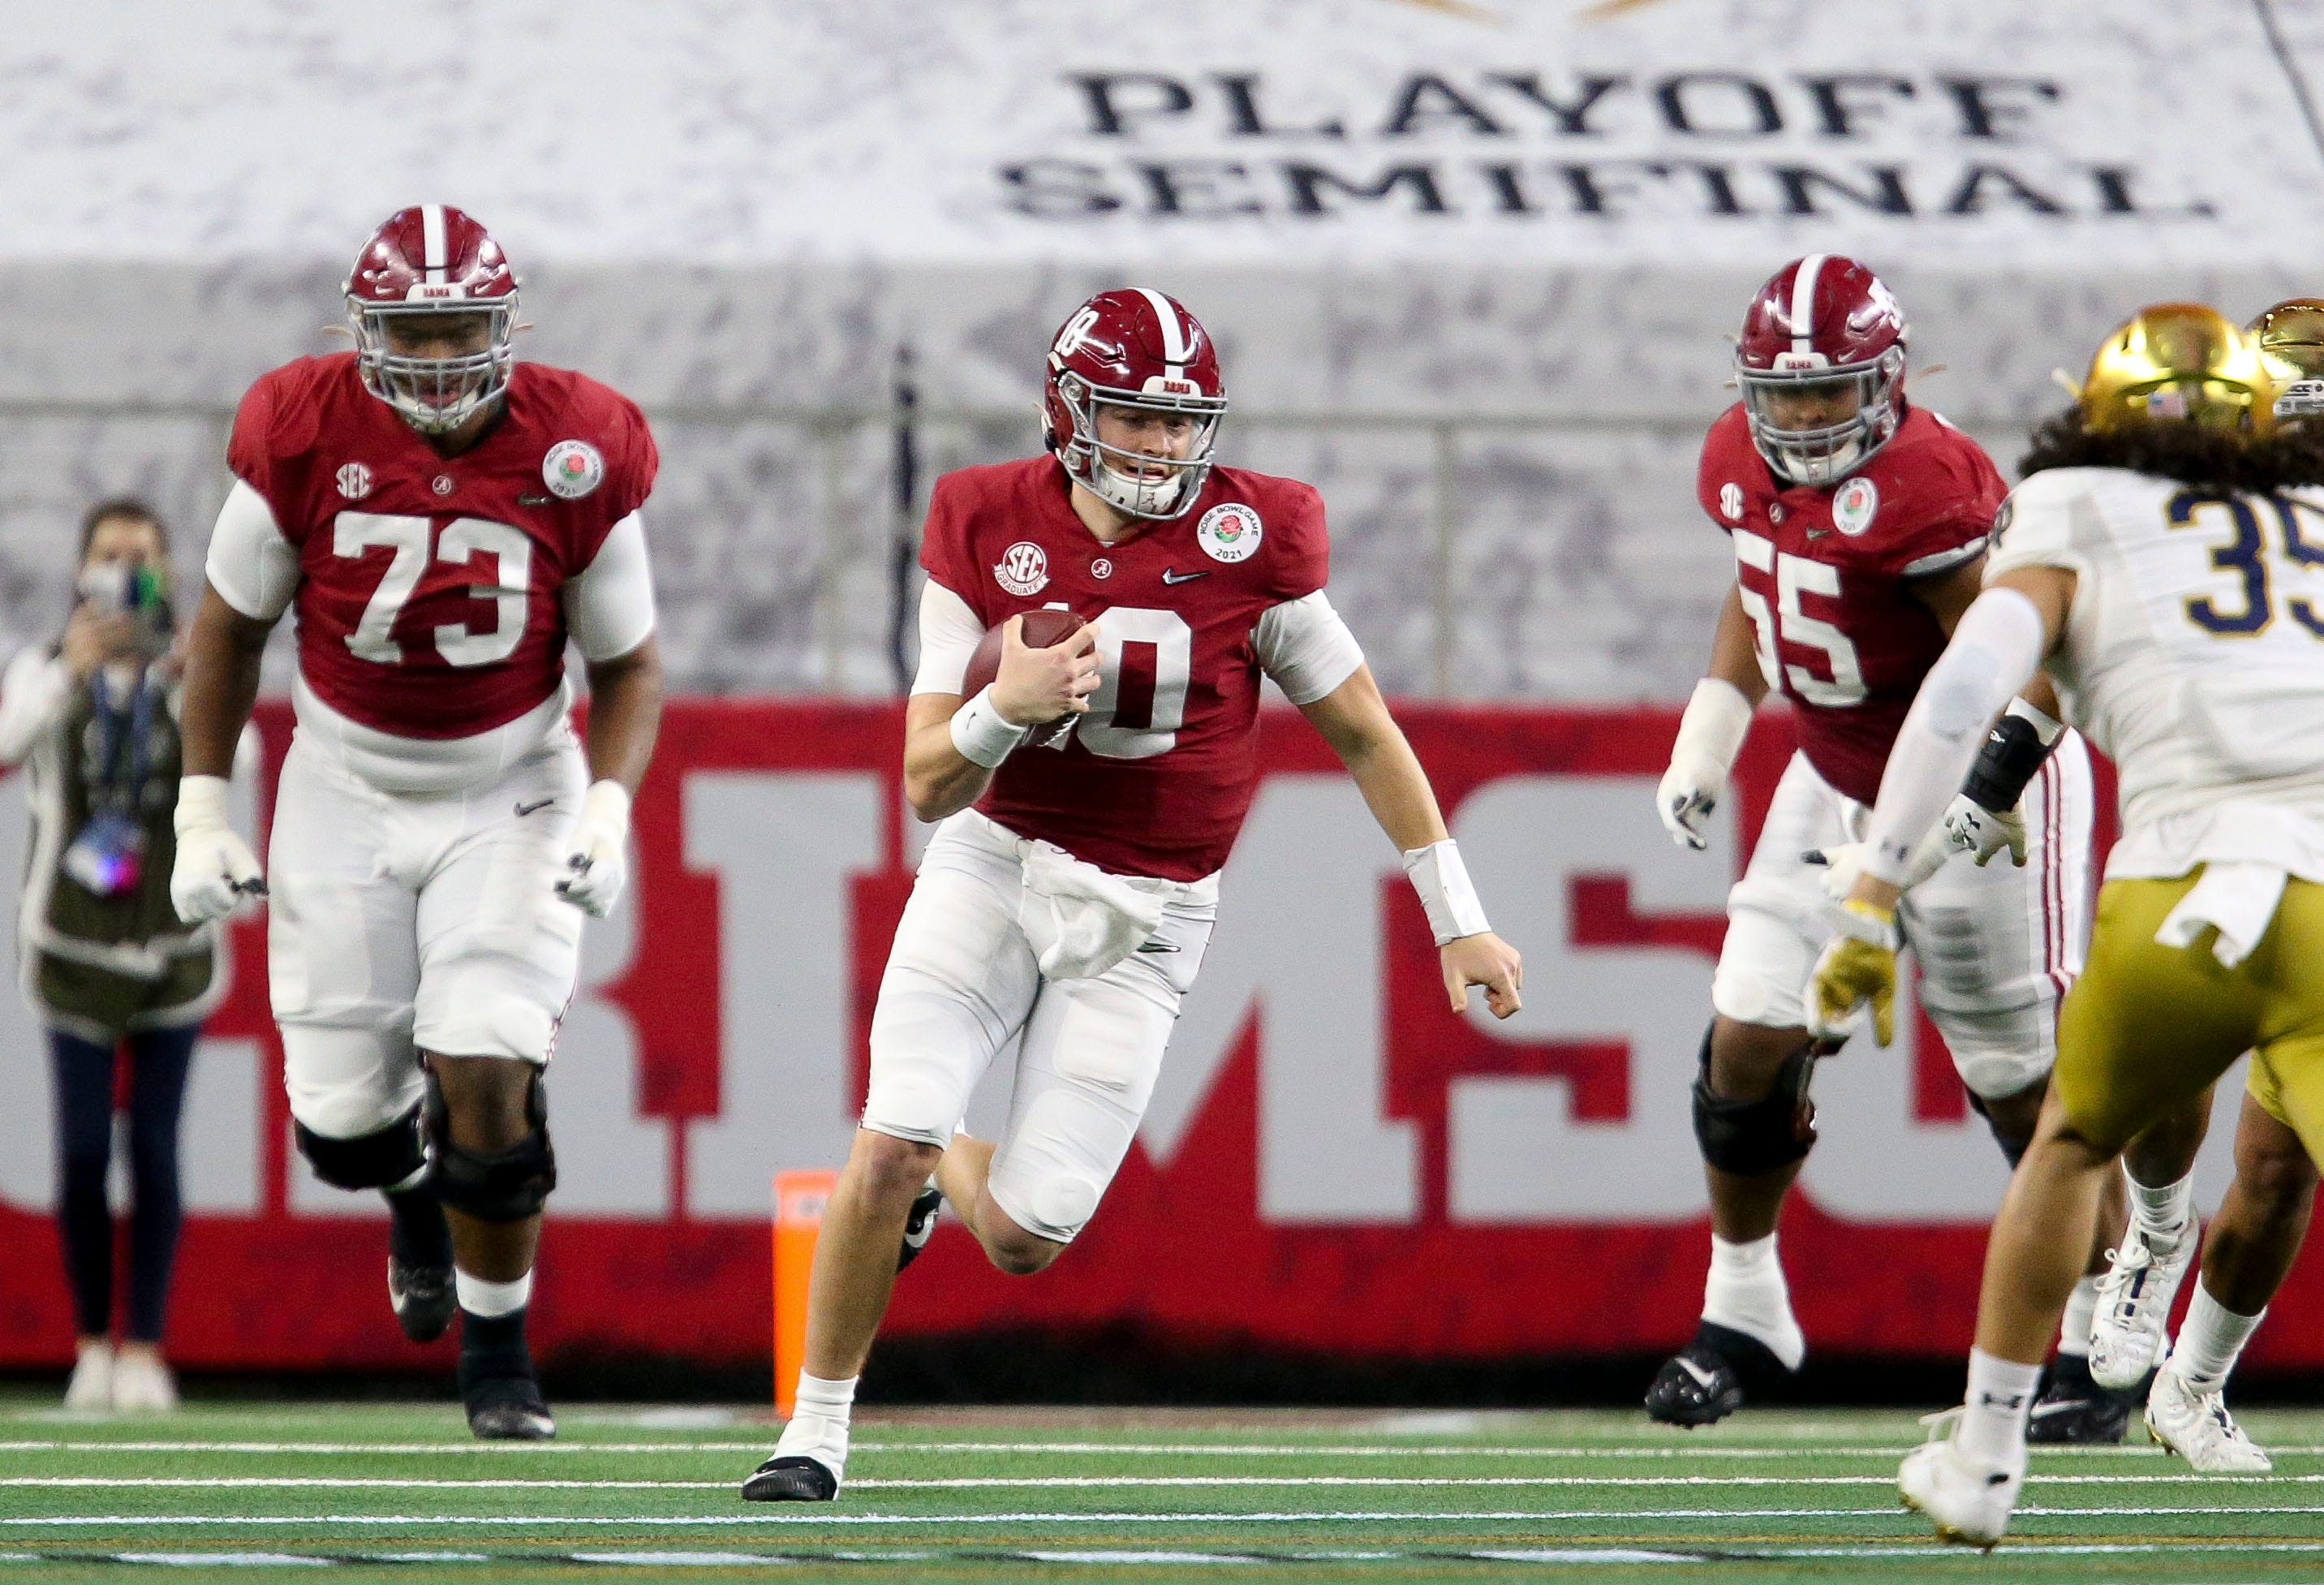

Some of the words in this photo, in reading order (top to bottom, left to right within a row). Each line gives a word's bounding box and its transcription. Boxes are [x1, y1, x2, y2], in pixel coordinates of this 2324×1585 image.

[1065, 71, 2063, 138] PLAYOFF
[1003, 160, 2218, 218] SEMIFINAL
[335, 462, 371, 498] SEC
[1200, 512, 1216, 535] ROSE
[1216, 505, 1244, 515] BOWL
[1244, 510, 1259, 536] GAME
[1006, 545, 1044, 583] SEC
[1215, 548, 1243, 559] 2021
[333, 510, 532, 669] 73
[996, 573, 1039, 595] GRADUATE
[1732, 528, 1868, 708] 55
